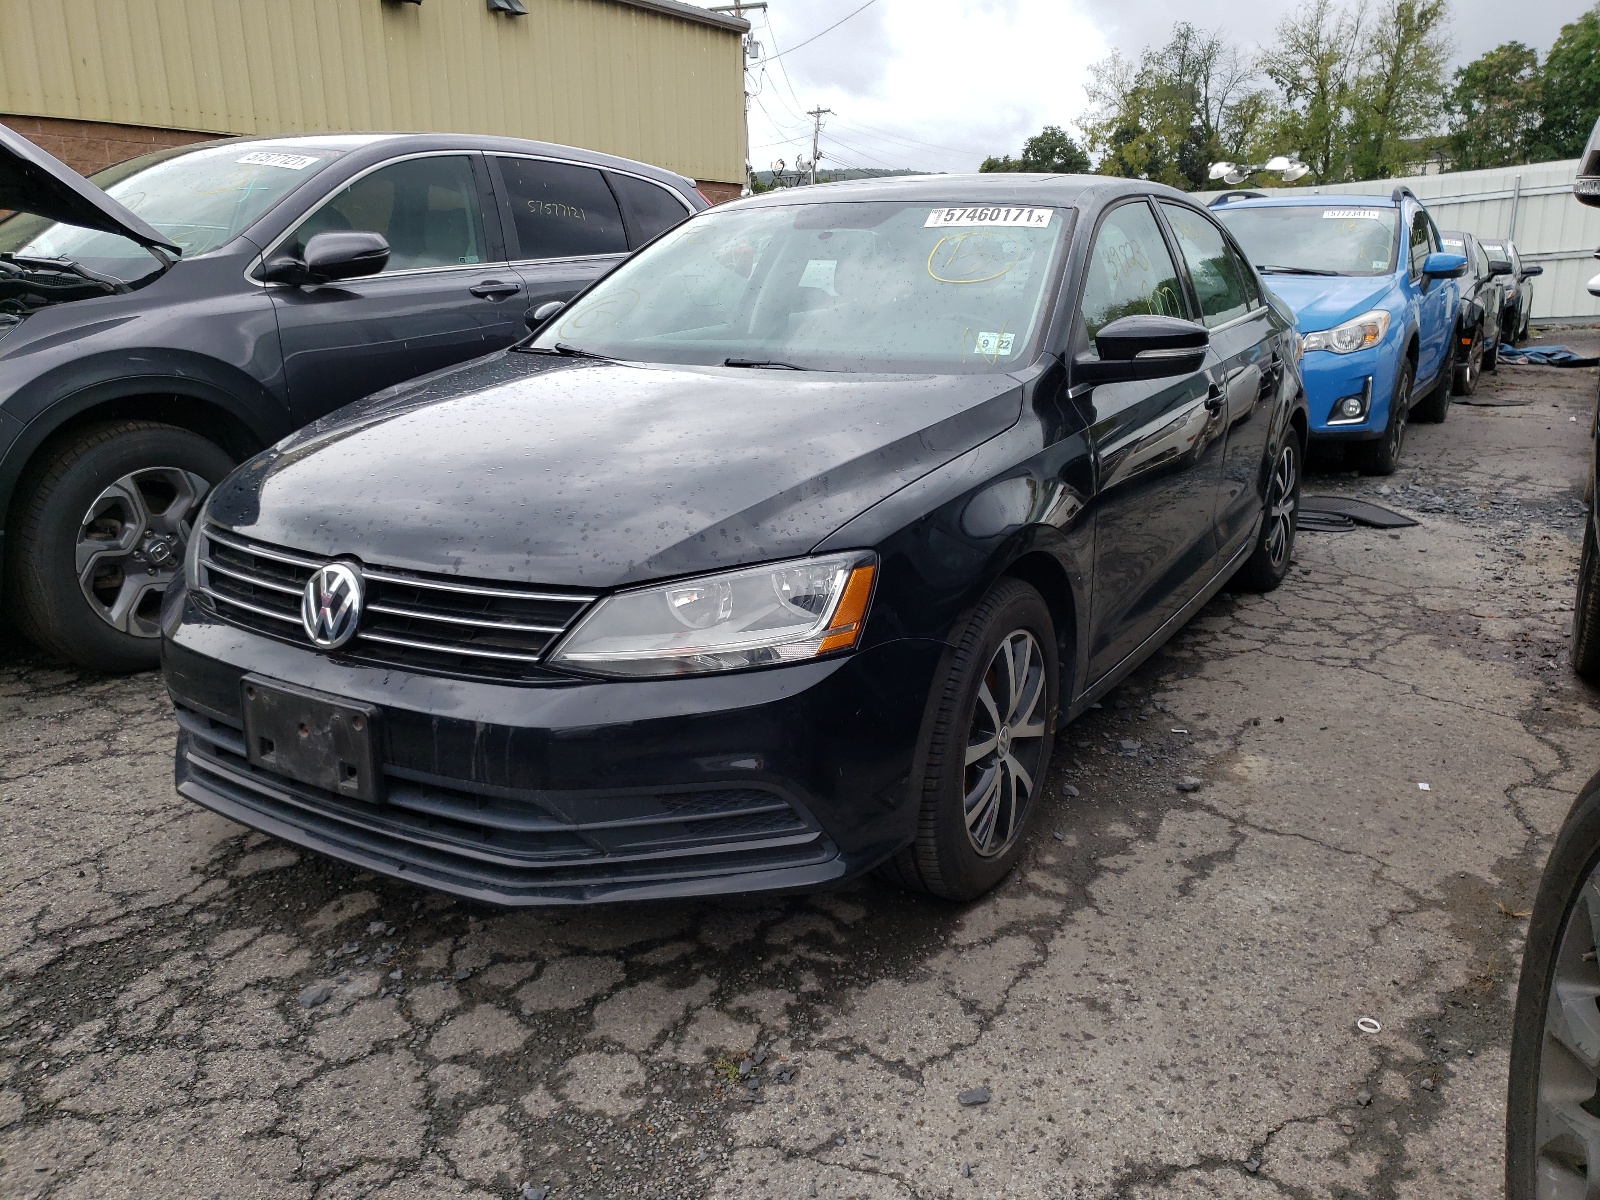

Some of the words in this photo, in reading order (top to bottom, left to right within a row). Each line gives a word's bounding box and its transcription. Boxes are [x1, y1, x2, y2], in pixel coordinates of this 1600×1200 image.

[527, 200, 586, 221] 57577121
[981, 339, 990, 348] 9
[999, 339, 1011, 349] 22
